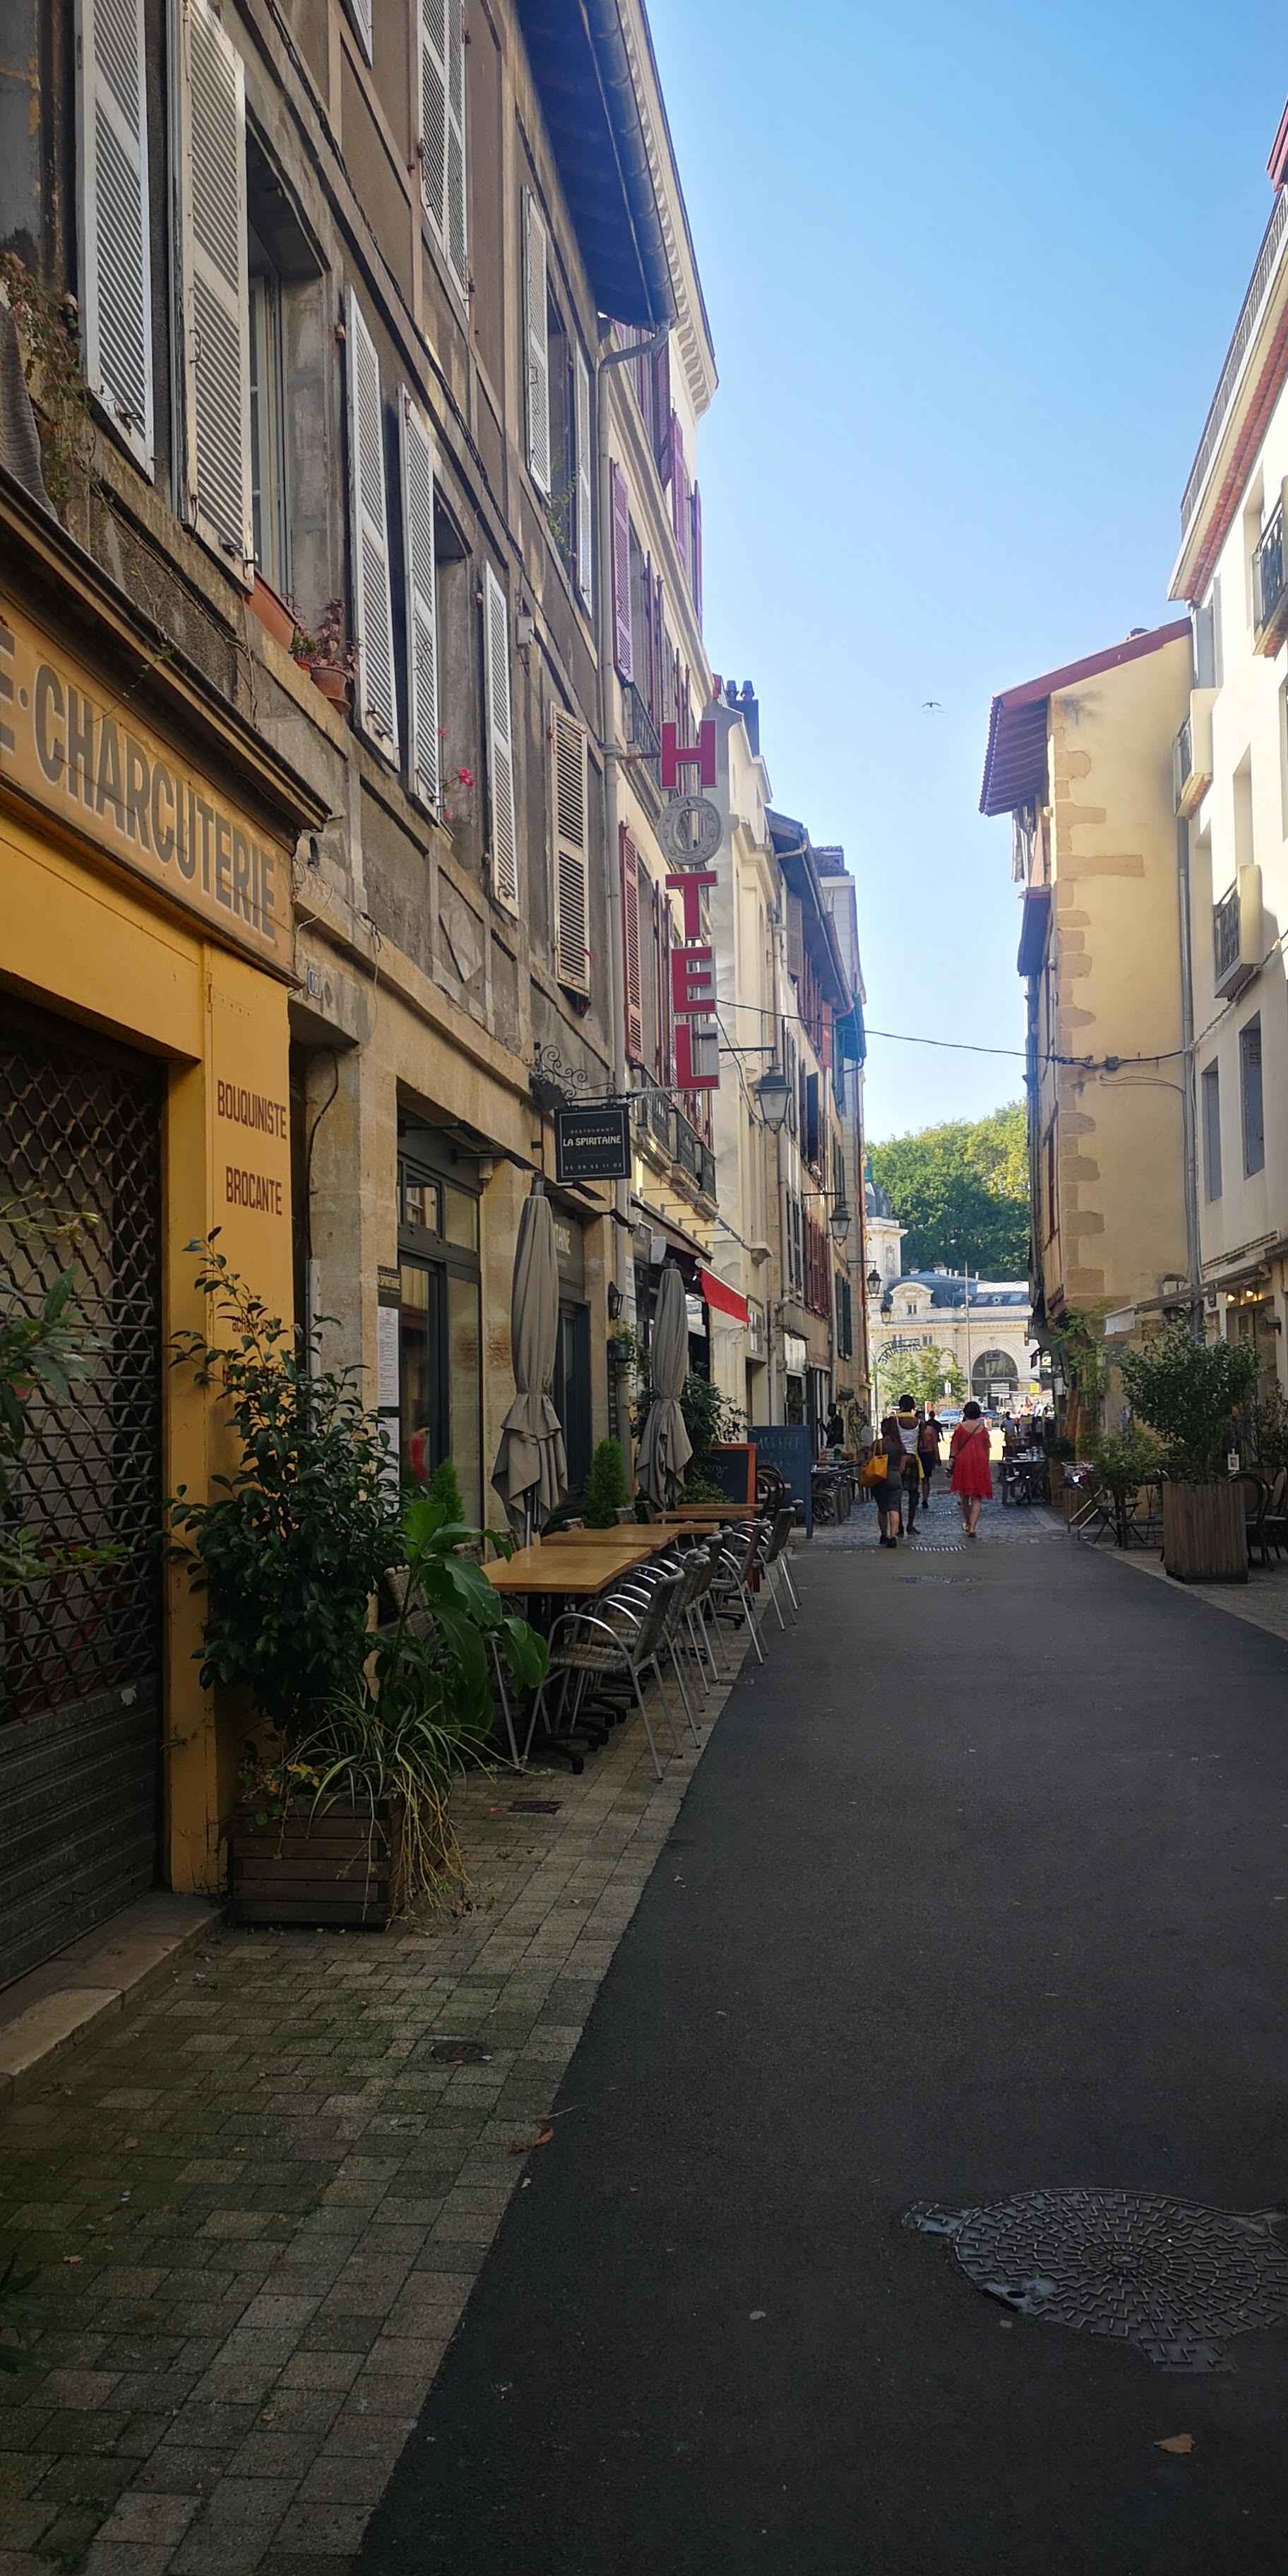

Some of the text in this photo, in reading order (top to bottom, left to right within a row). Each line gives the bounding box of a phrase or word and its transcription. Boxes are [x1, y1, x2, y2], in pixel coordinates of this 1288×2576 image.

[33, 664, 276, 944] CHARCUTERIE
[657, 719, 724, 1090] HOTEL
[217, 1079, 287, 1140] BOUQUINISTE
[563, 1135, 621, 1147] LA SPIRITAINE
[225, 1165, 282, 1216] BROCANTE
